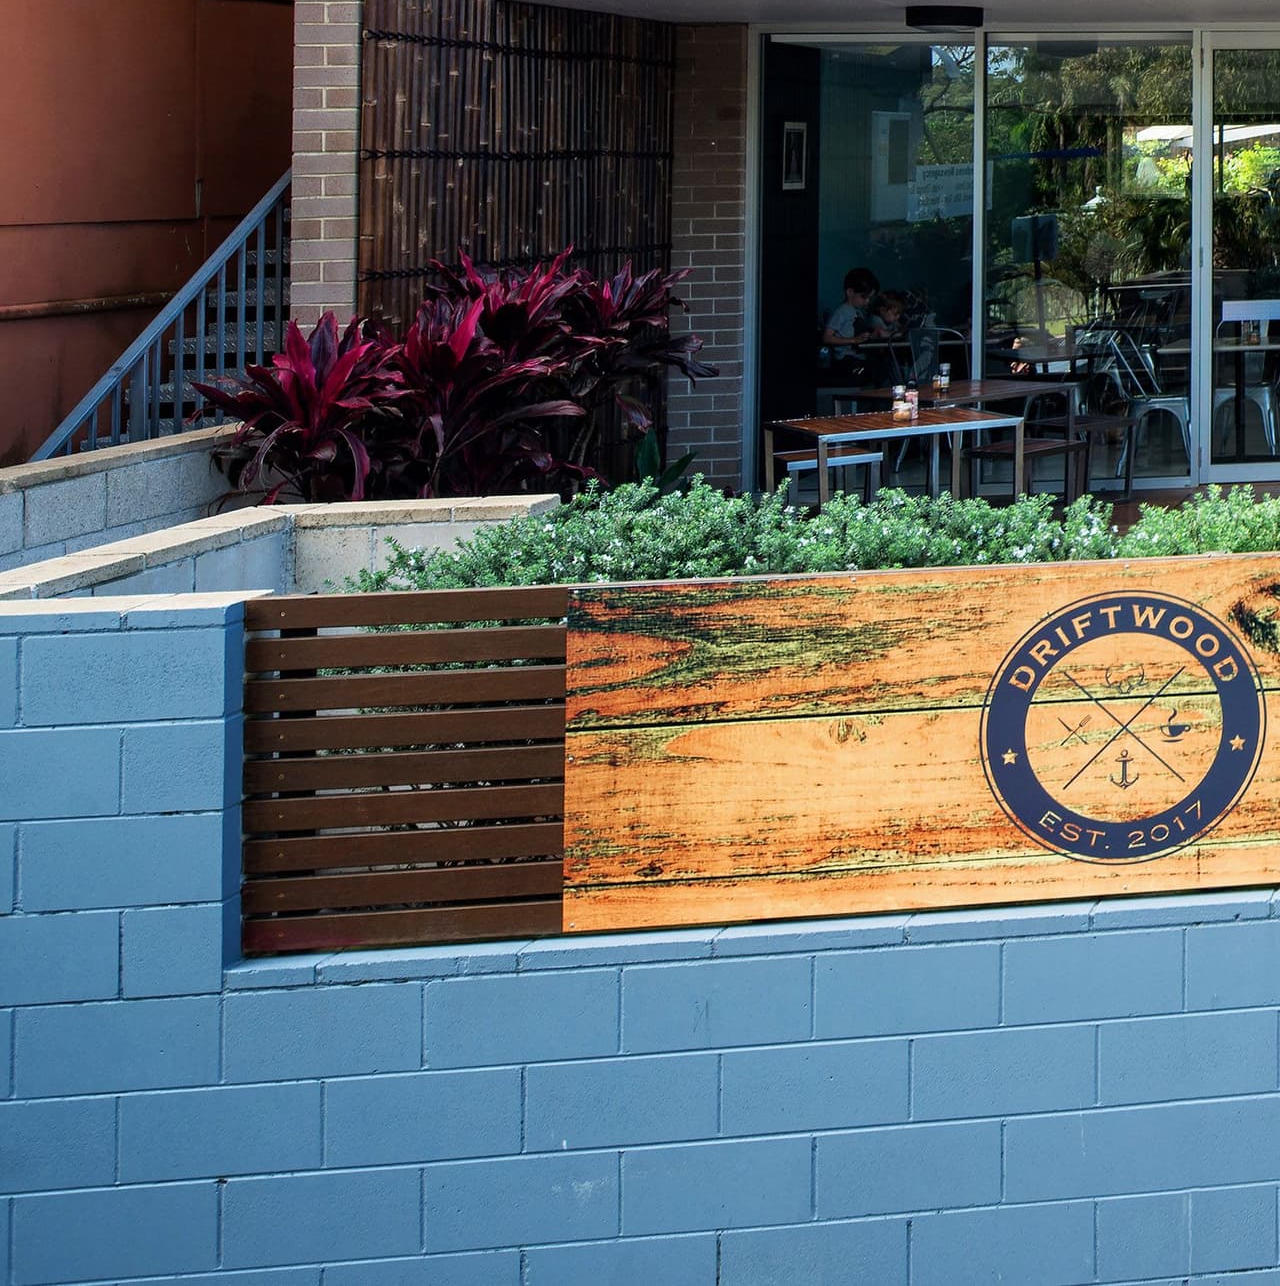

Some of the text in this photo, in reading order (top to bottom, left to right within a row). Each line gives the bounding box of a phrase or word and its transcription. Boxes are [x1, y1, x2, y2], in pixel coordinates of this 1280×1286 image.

[1008, 604, 1240, 693] DRIFTWOOD
[1037, 799, 1205, 851] EST. 2017
